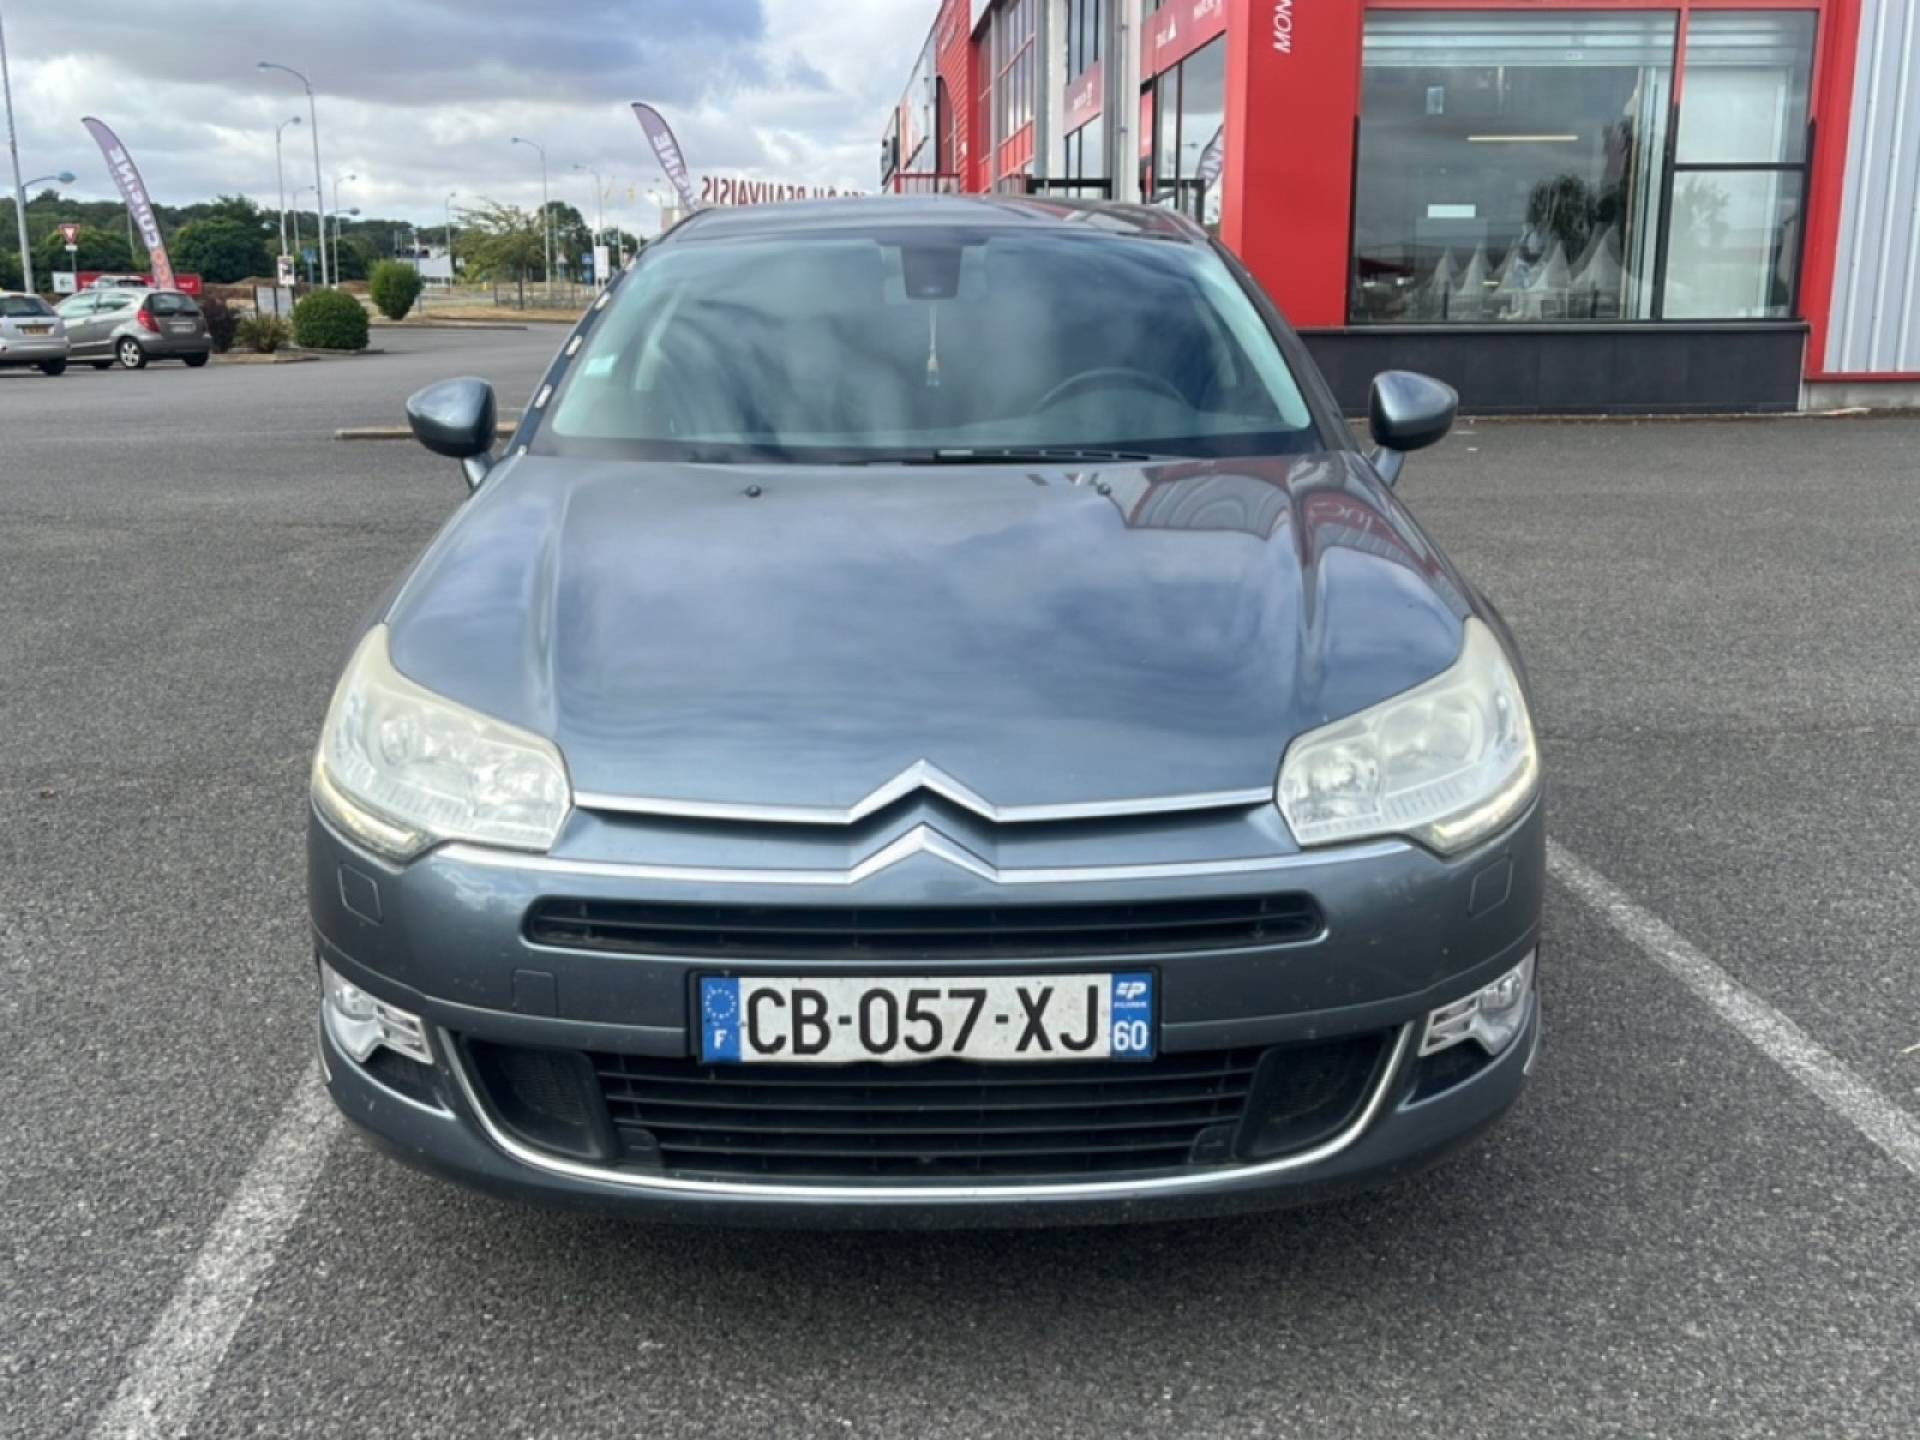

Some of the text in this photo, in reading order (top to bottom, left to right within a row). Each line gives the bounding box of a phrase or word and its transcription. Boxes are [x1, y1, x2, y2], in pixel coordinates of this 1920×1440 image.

[746, 985, 1099, 1055] CB-057-XJ
[1113, 1020, 1148, 1051] 60
[713, 1030, 728, 1049] F
